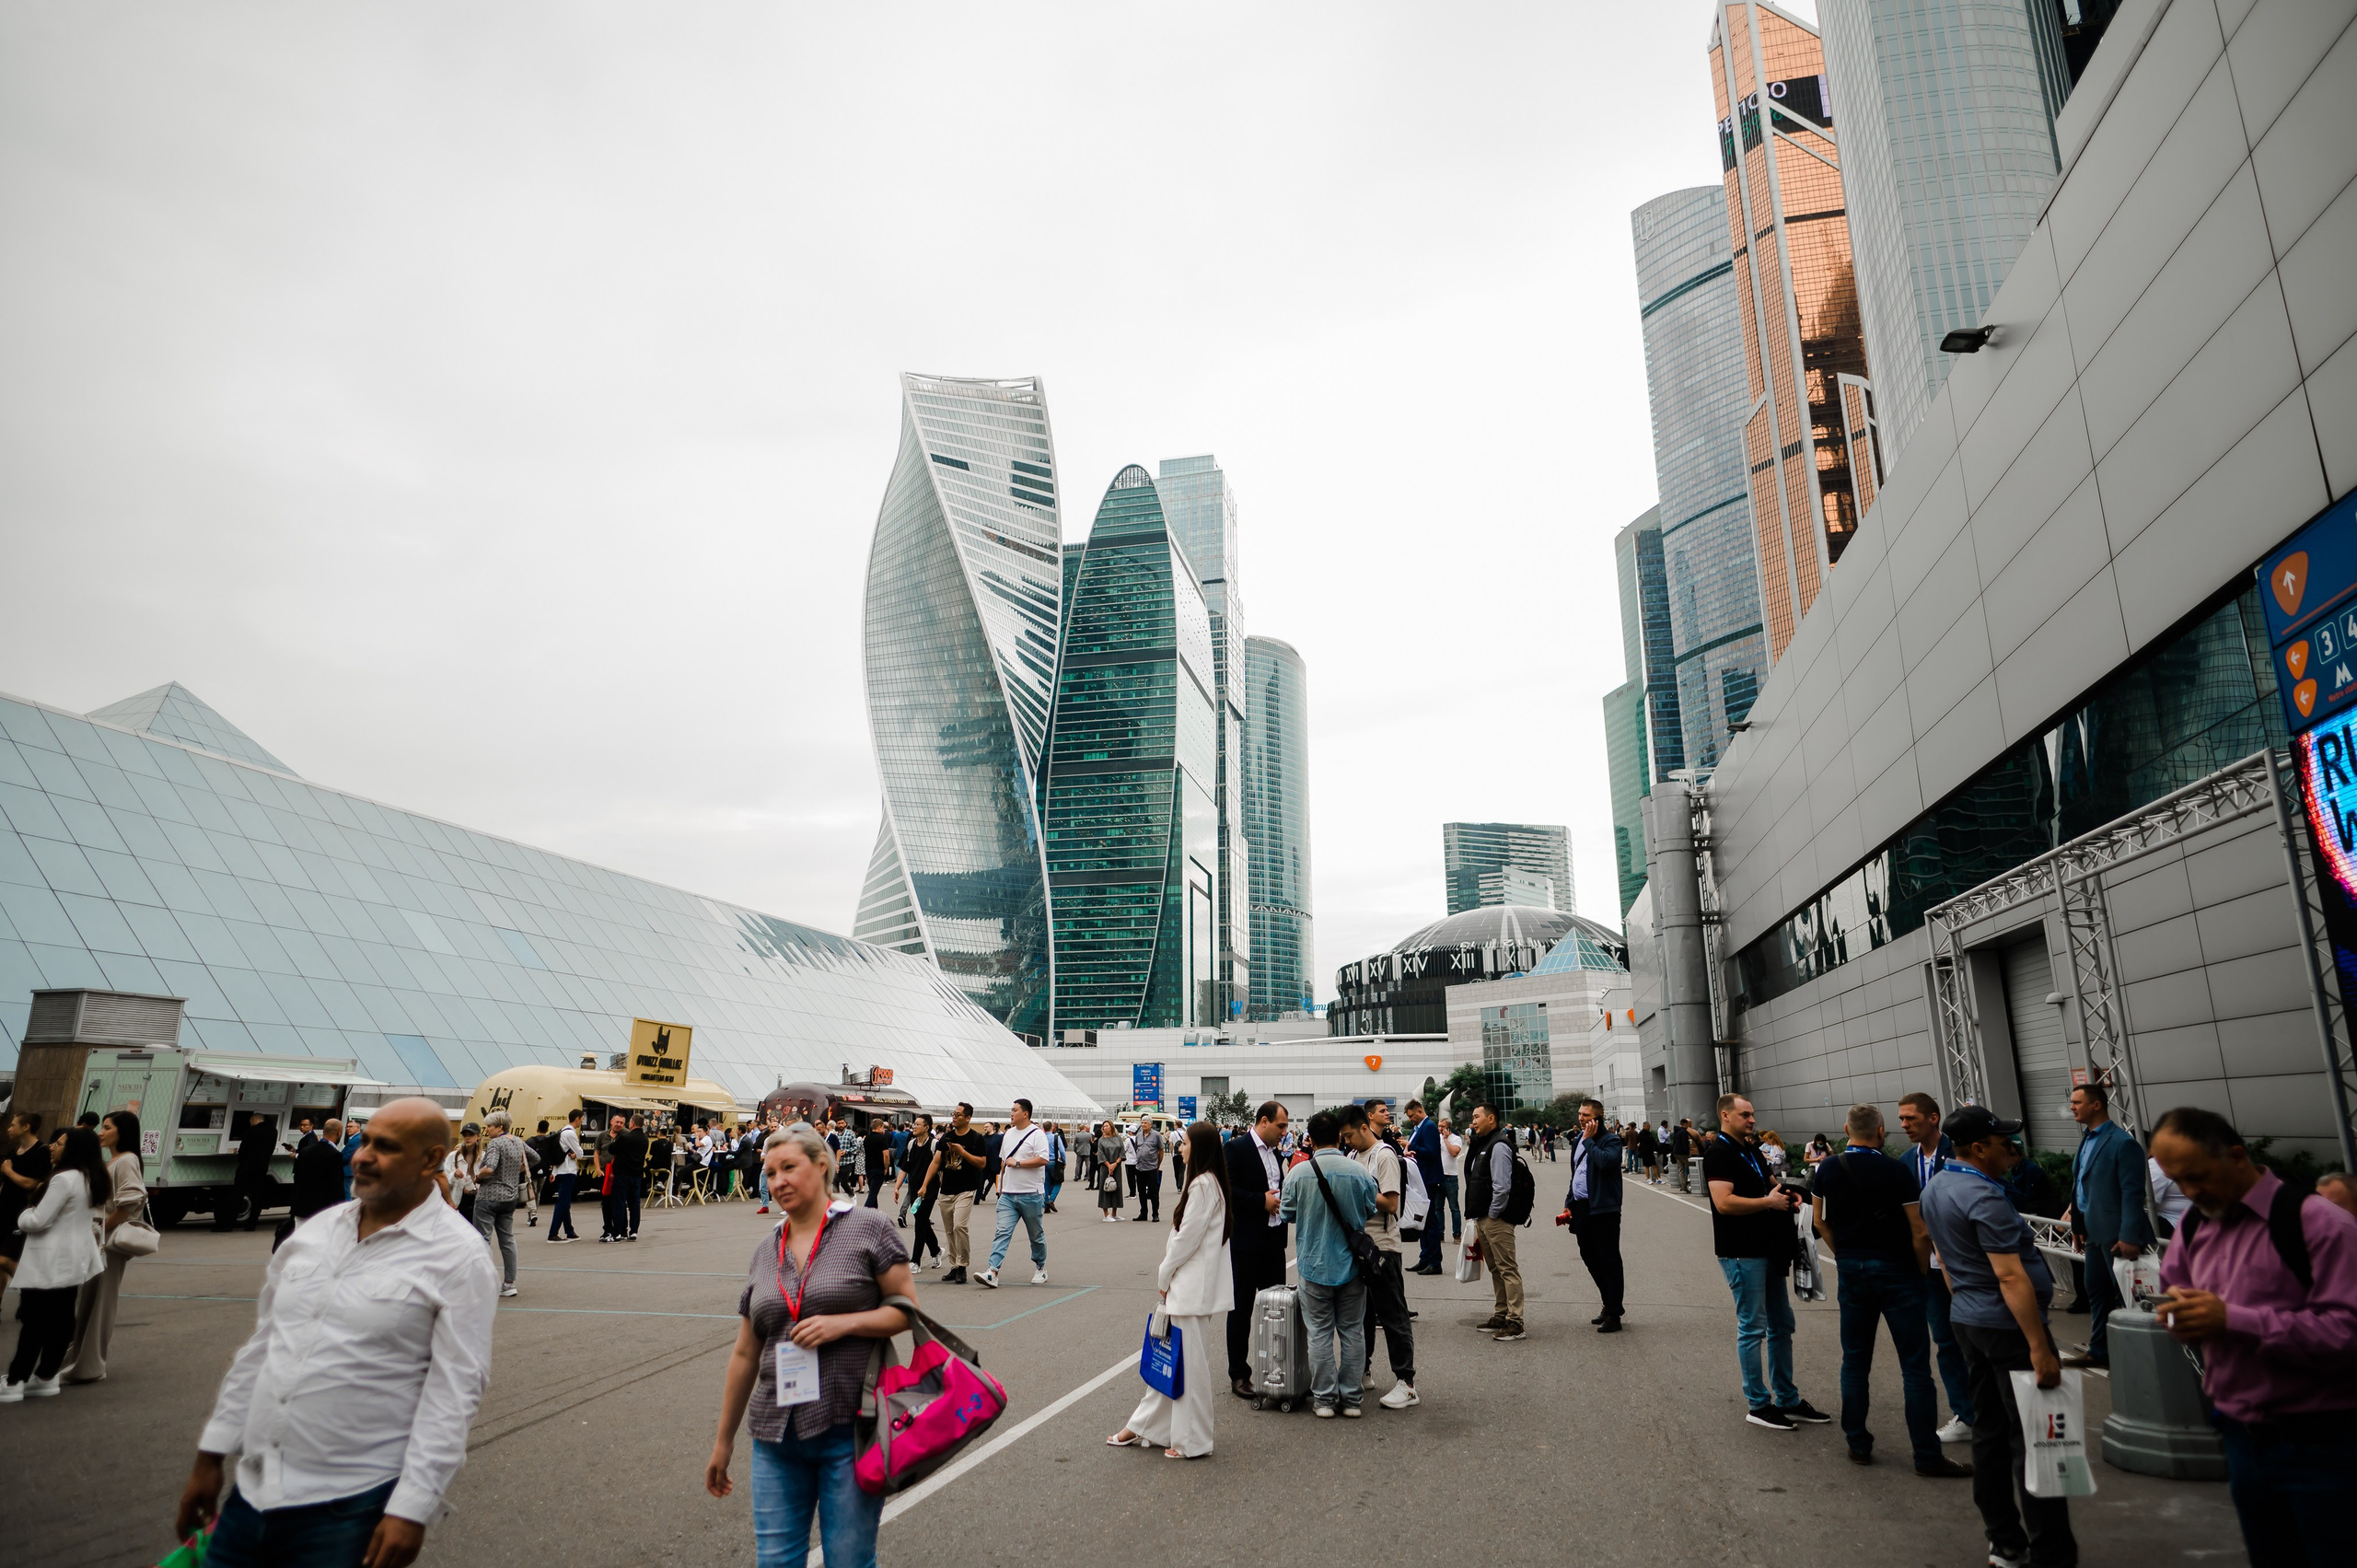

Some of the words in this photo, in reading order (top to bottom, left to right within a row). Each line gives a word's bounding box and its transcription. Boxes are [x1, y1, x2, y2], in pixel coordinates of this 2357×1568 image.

[2321, 630, 2334, 656] 3
[2348, 614, 2357, 639] 4
[1370, 960, 1387, 977] XV
[1402, 956, 1428, 973] XIV
[1451, 952, 1475, 970] XIII
[1371, 1058, 1376, 1066] 7
